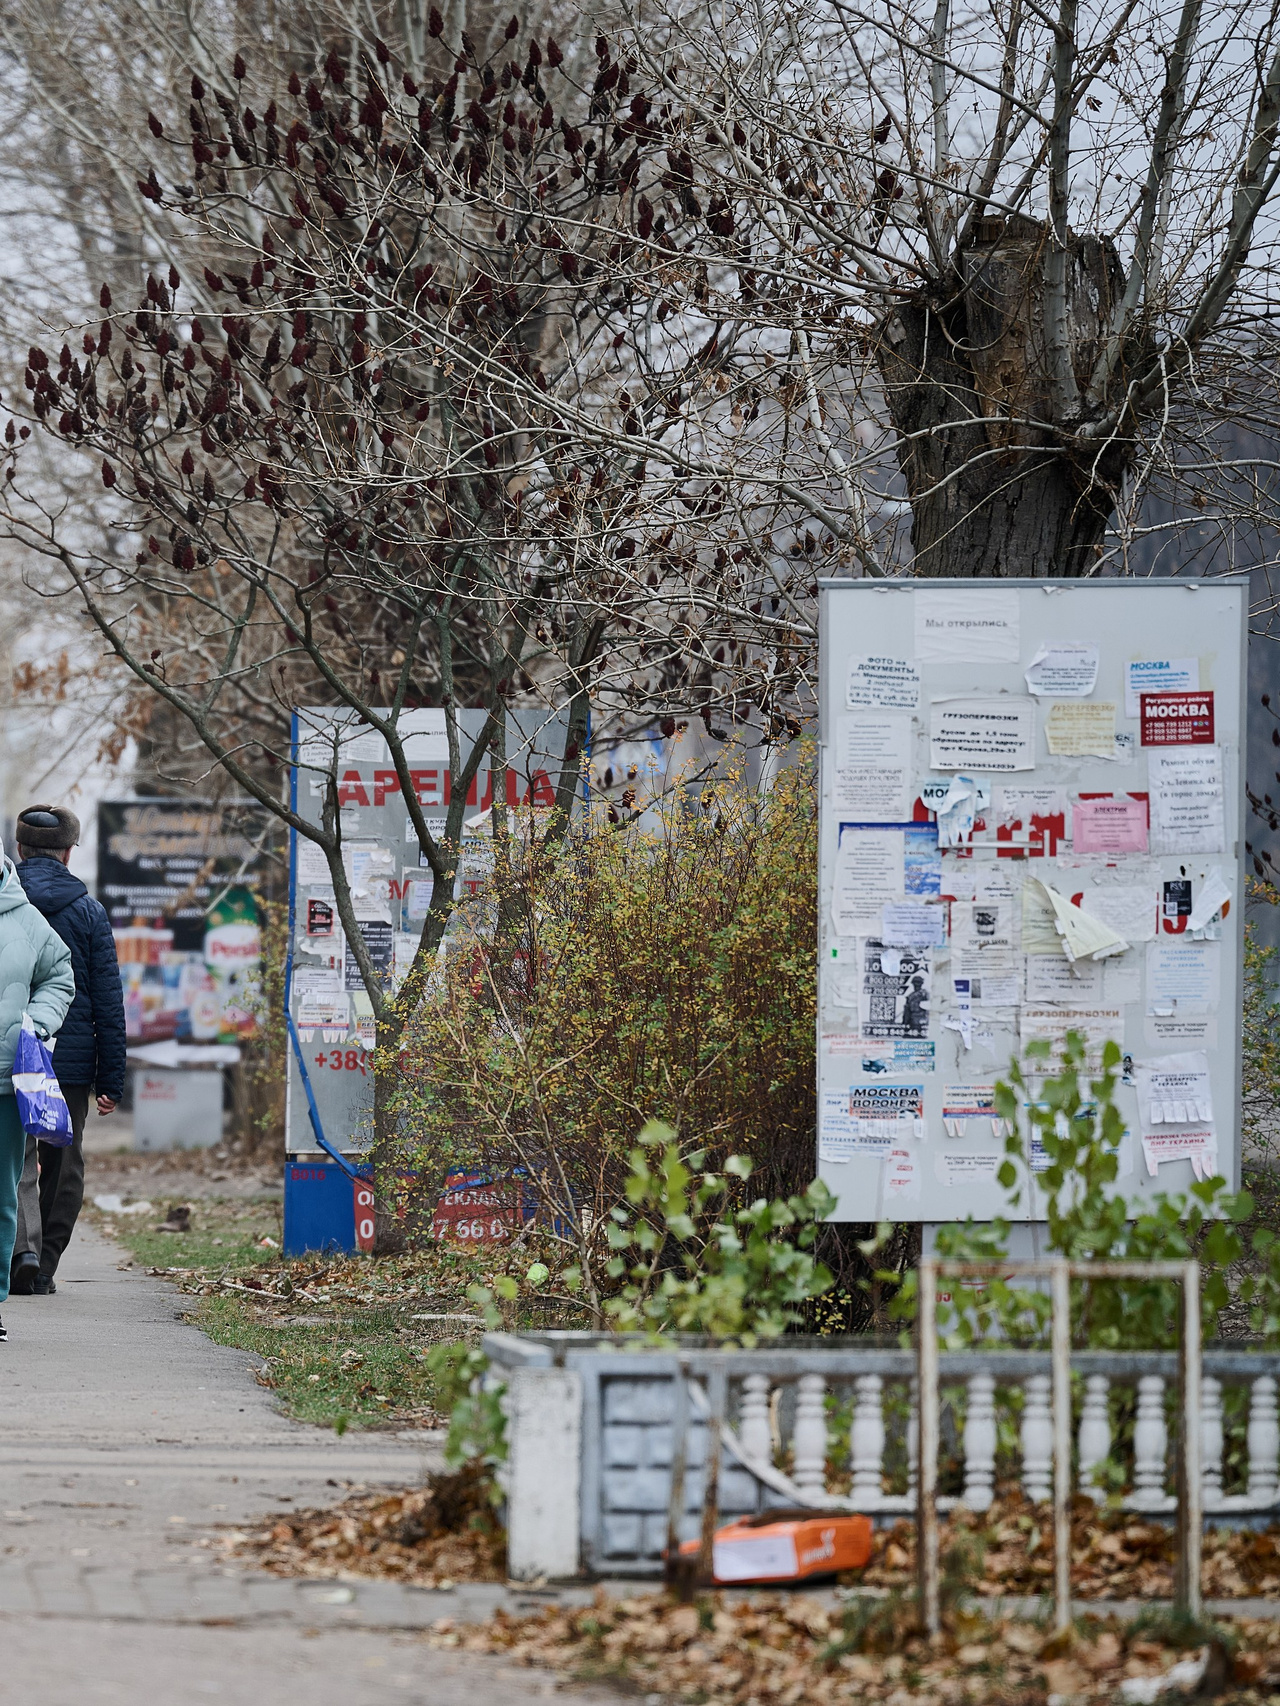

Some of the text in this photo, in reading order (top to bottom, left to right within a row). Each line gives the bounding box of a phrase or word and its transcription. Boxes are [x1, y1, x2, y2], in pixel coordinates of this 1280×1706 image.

[925, 619, 1008, 630] Мы открылись
[867, 657, 893, 665] ФОТО
[1130, 661, 1170, 671] МОСКВА
[857, 663, 915, 674] ДОКУМЕНТЫ
[1145, 704, 1210, 718] МОСКВА
[942, 712, 1019, 721] ГРУЗОПЕРЕВОЗКИ
[1026, 1010, 1120, 1018] ГРУЗОПЕРЕВОЗКИ
[854, 1088, 919, 1098] МОСКВА
[853, 1099, 919, 1108] ВОРОНЕЖ
